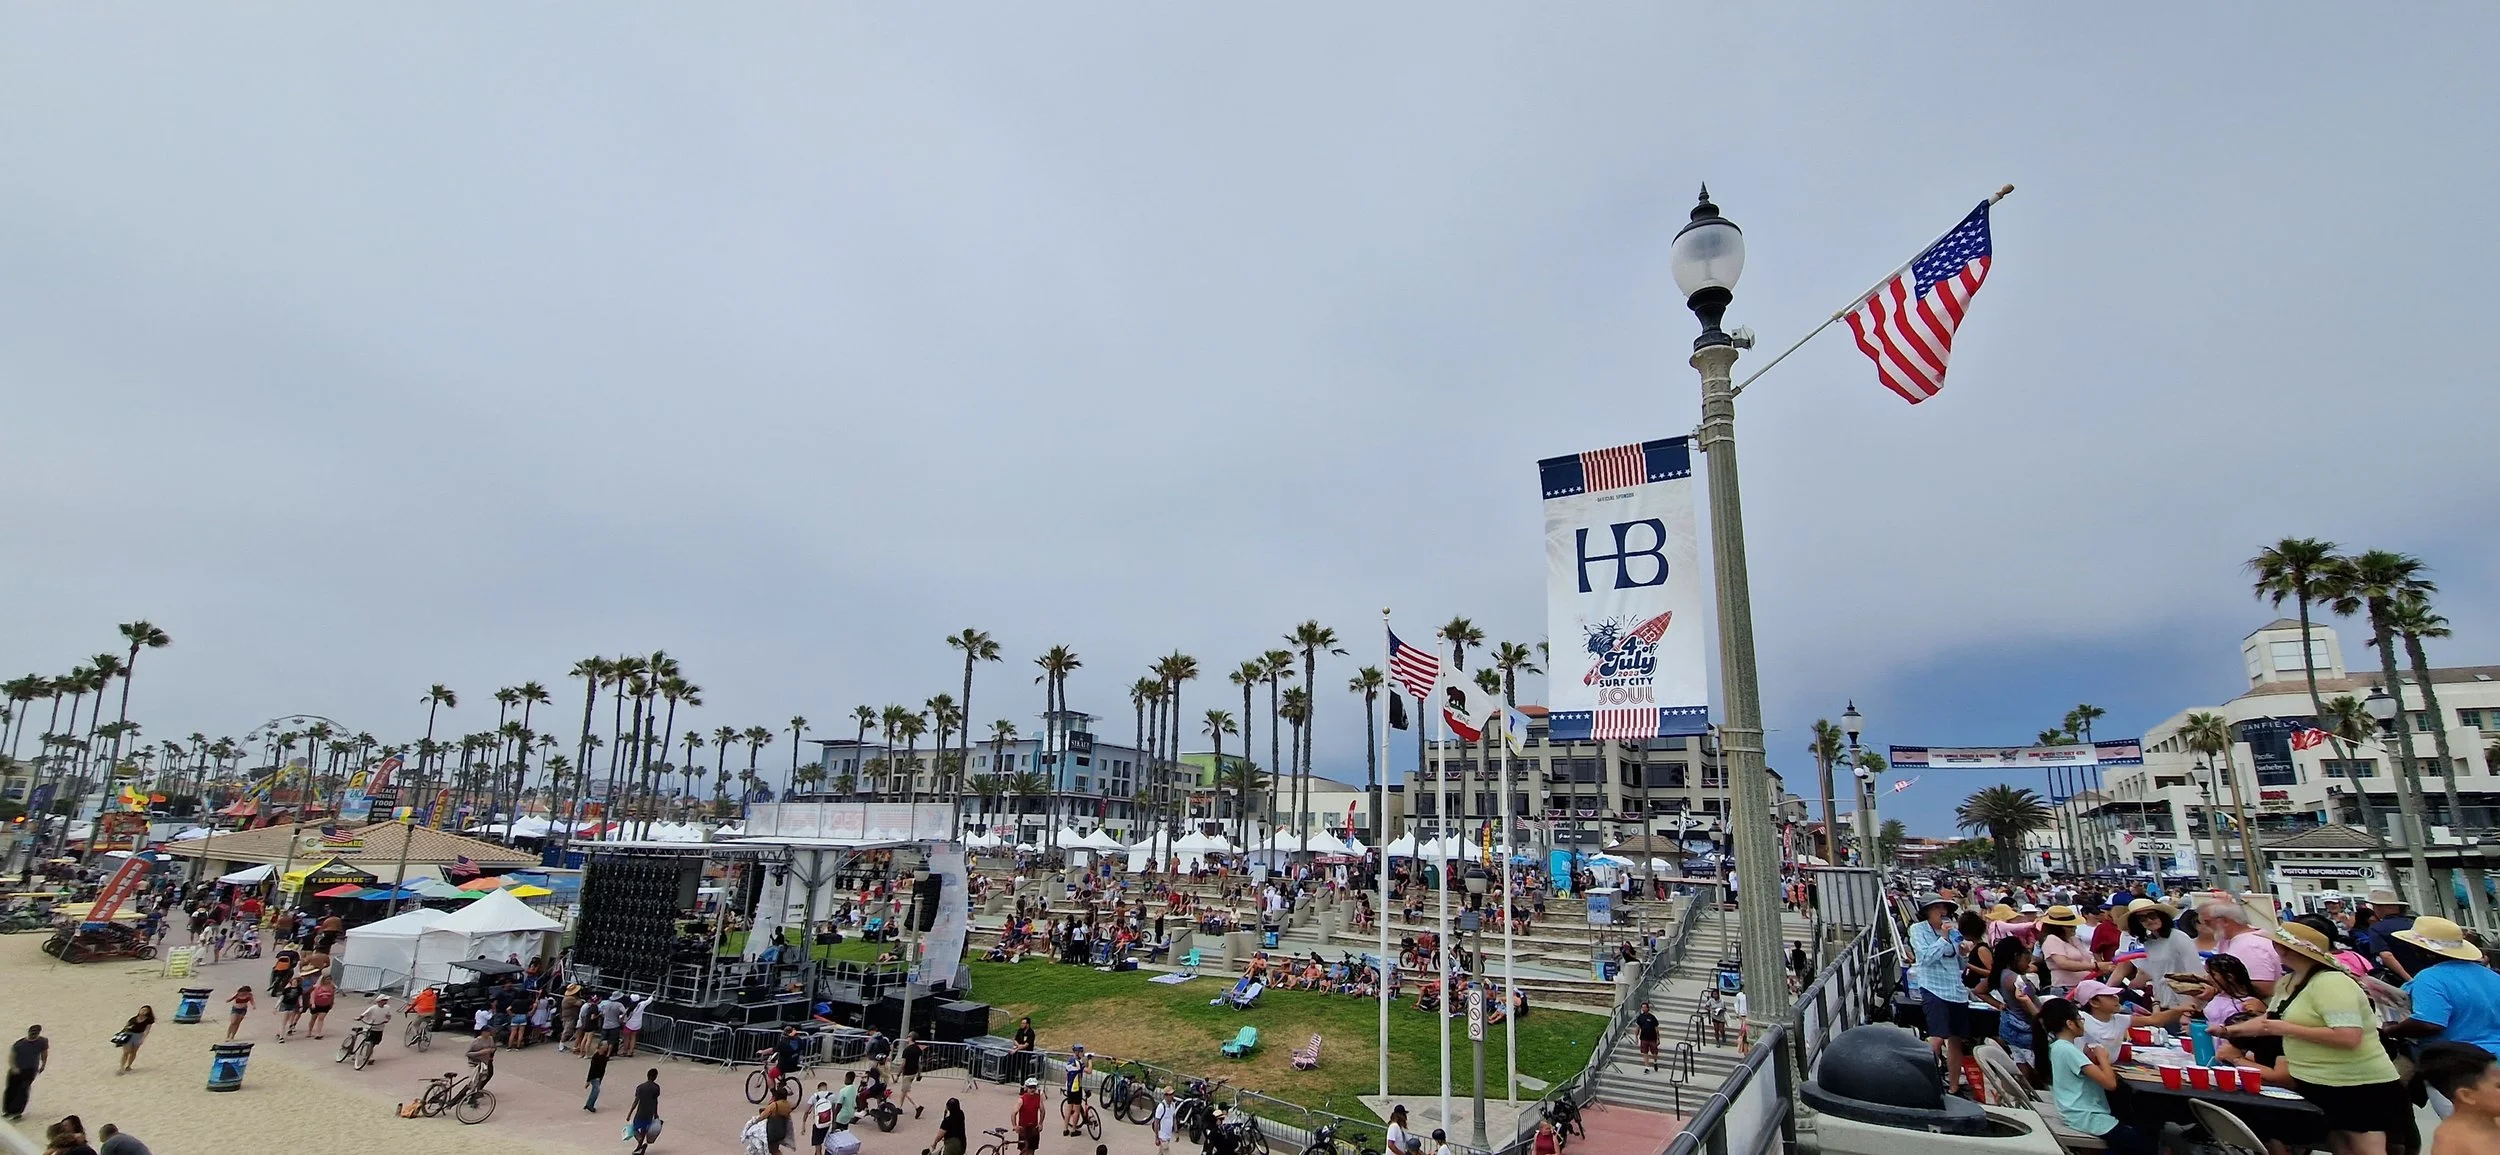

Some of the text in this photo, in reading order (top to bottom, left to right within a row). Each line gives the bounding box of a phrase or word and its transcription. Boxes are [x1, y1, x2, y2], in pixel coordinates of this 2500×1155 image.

[1576, 518, 1669, 593] HB
[1642, 643, 1659, 655] of
[1600, 650, 1657, 677] July
[1600, 677, 1654, 688] SURF CITY
[1599, 686, 1655, 706] SOUL
